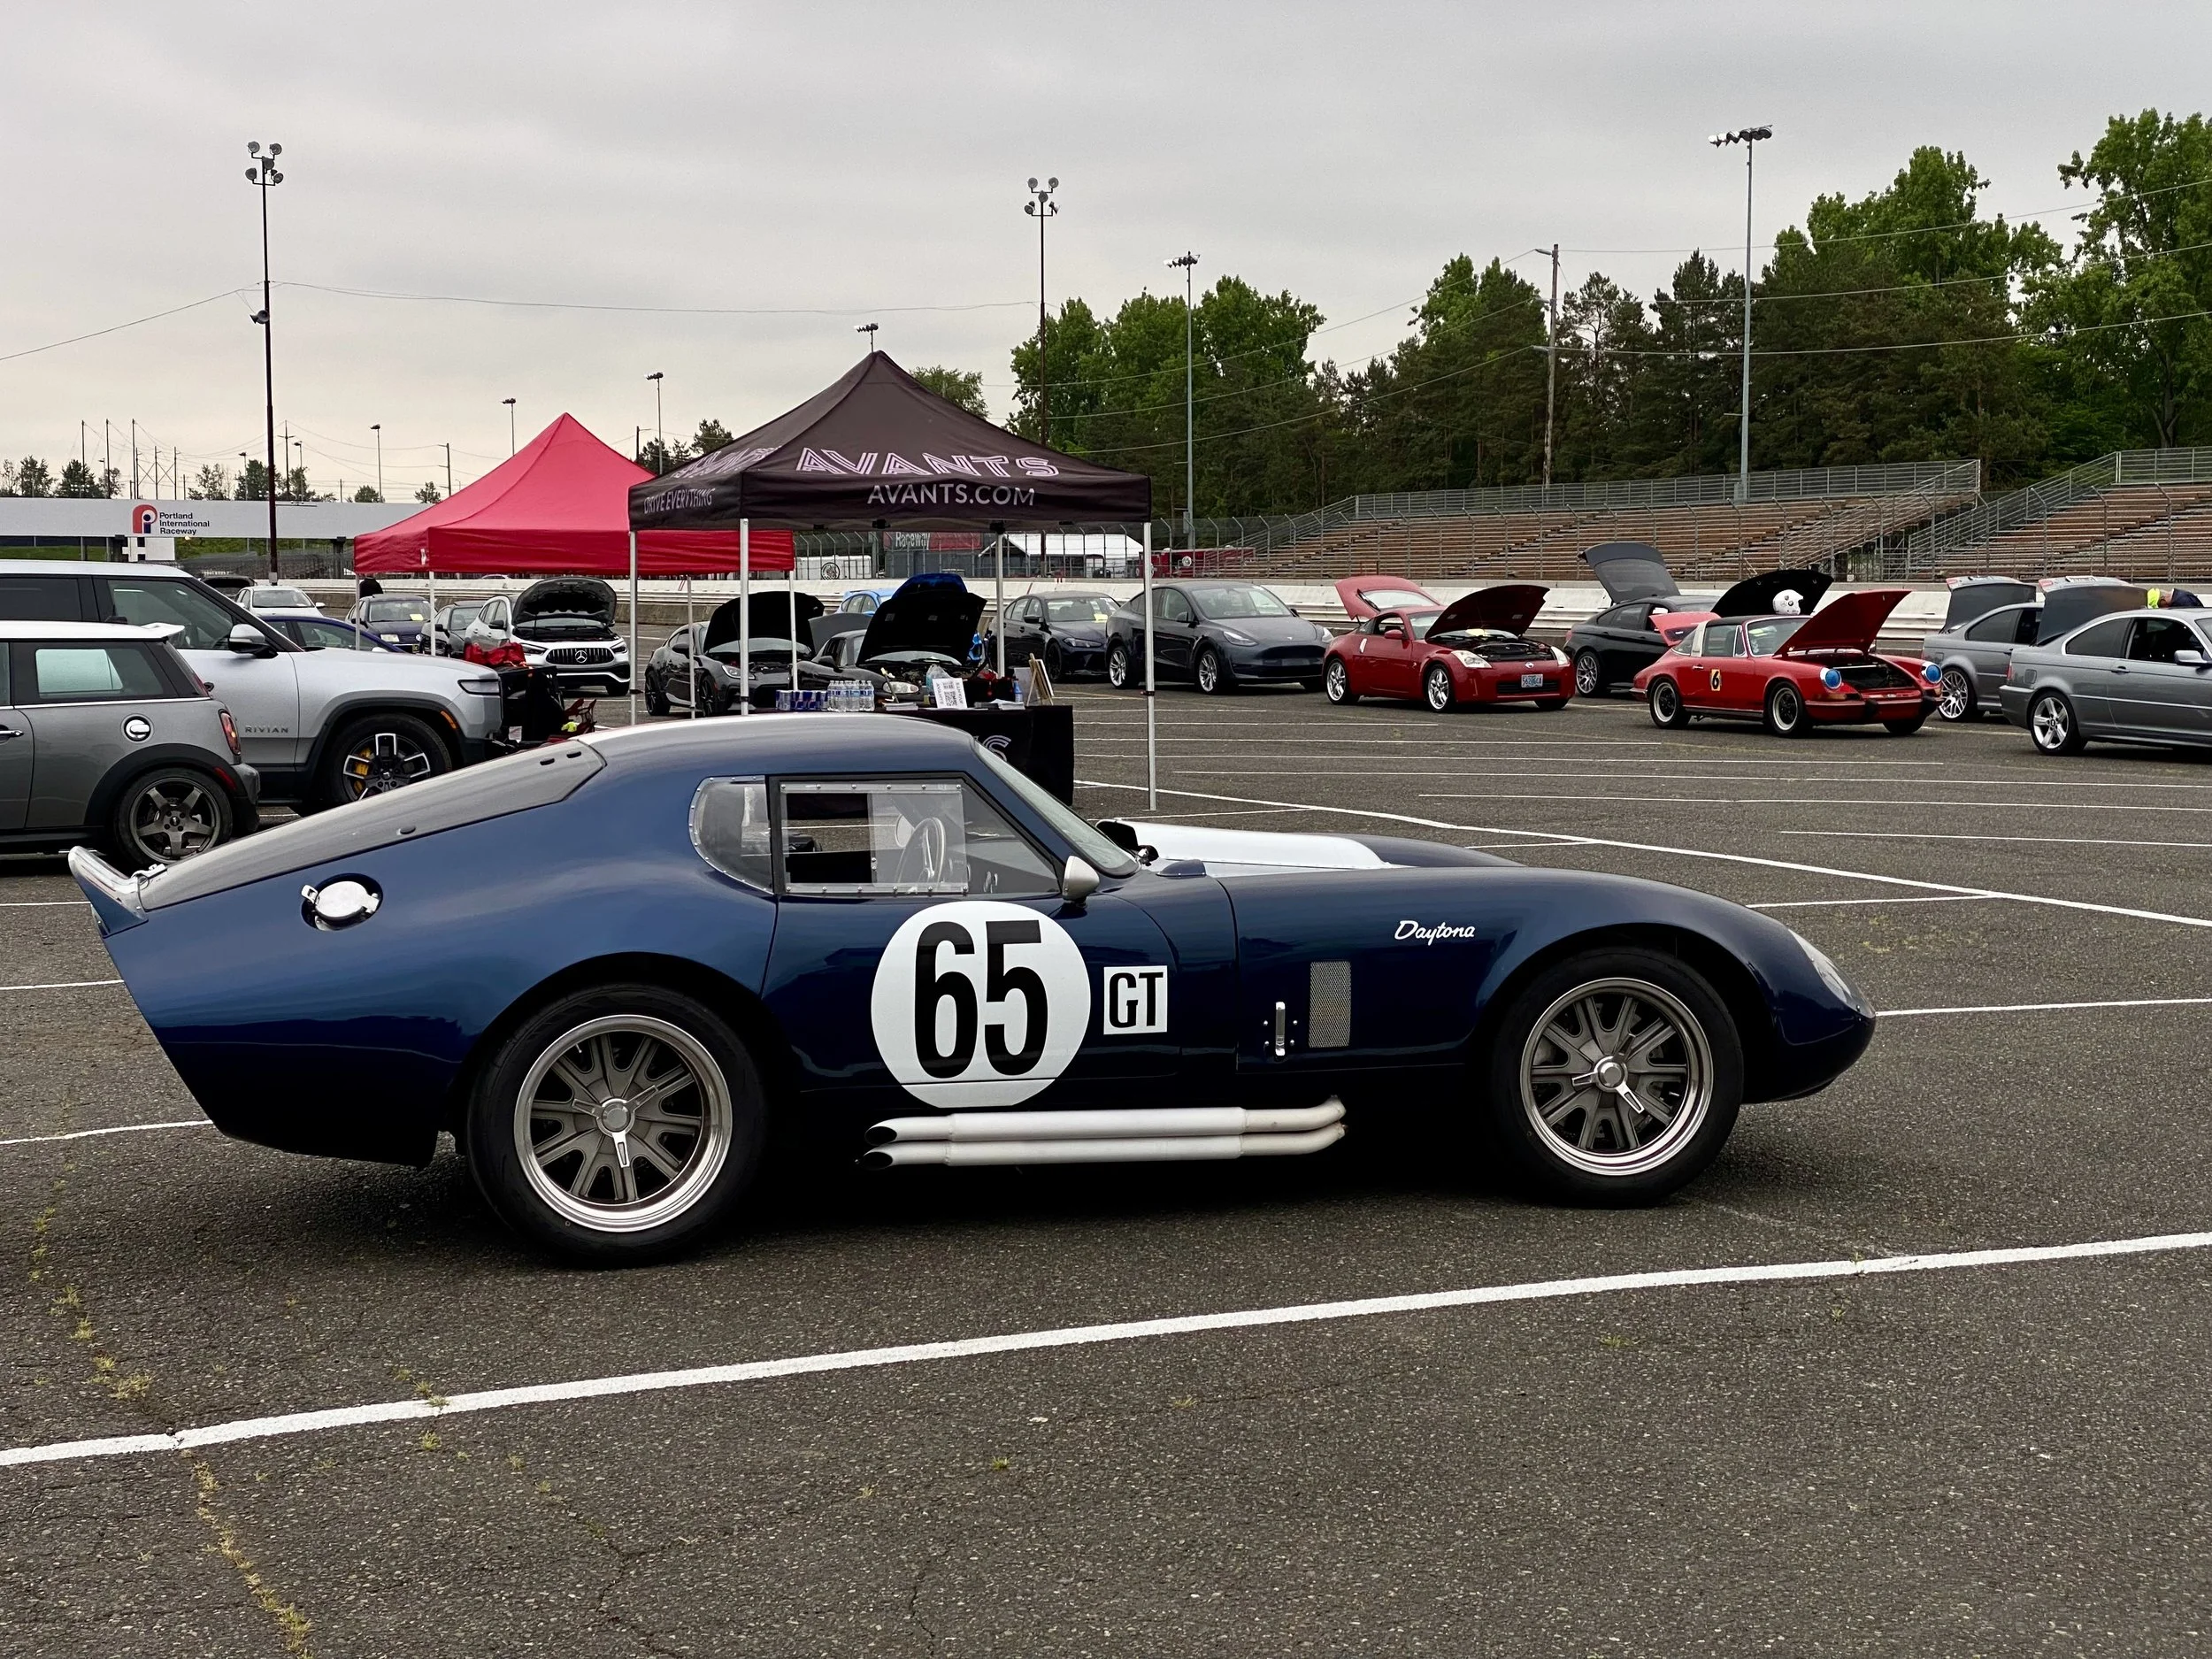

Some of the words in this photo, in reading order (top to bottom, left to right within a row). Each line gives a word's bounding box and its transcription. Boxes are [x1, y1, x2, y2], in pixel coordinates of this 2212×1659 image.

[797, 447, 1059, 478] AVANTS
[643, 494, 665, 514] DRIVE
[665, 488, 716, 511] EVERYTHING
[867, 483, 1035, 506] AVANTS.COM
[895, 531, 931, 550] Raceway
[1712, 671, 1719, 689] 6
[1394, 920, 1476, 946] Daytona
[914, 919, 1048, 1079] 65
[1109, 972, 1164, 1028] GT
